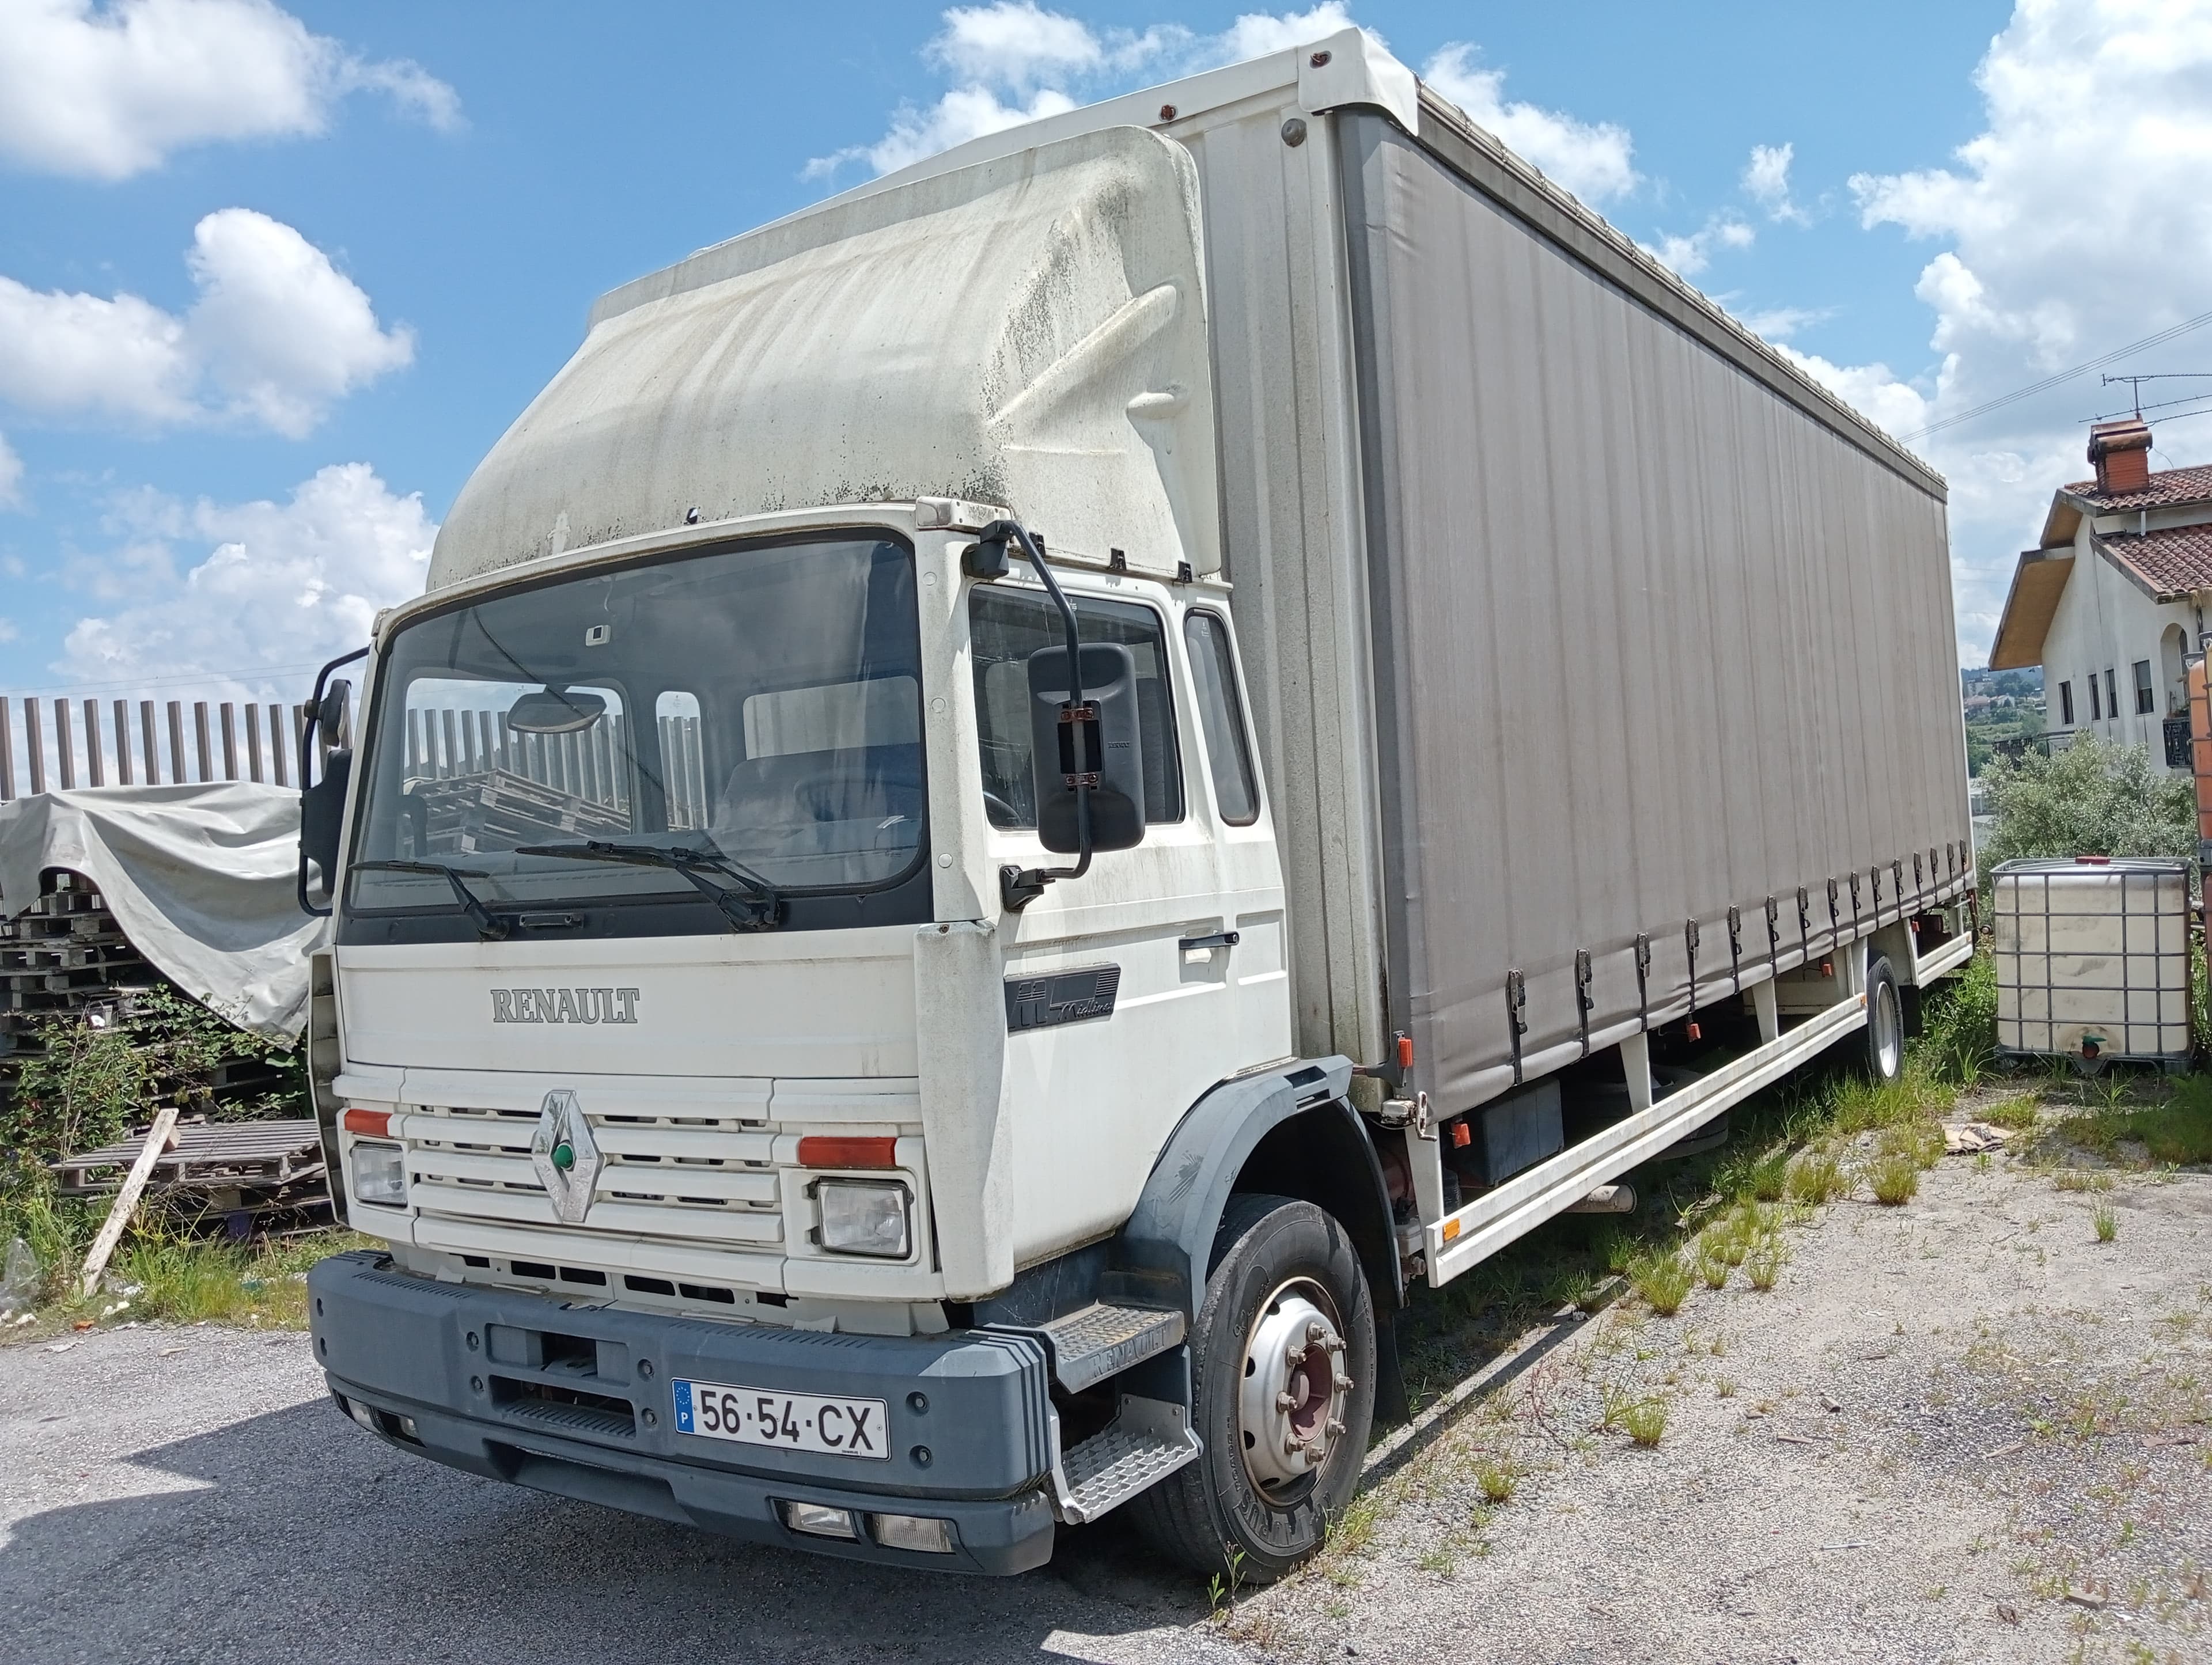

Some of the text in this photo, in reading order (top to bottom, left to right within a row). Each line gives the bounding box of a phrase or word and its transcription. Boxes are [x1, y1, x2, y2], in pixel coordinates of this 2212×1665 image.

[490, 988, 641, 1025] RENAULT
[1088, 1324, 1167, 1378] RENAULT
[680, 1412, 689, 1424] P
